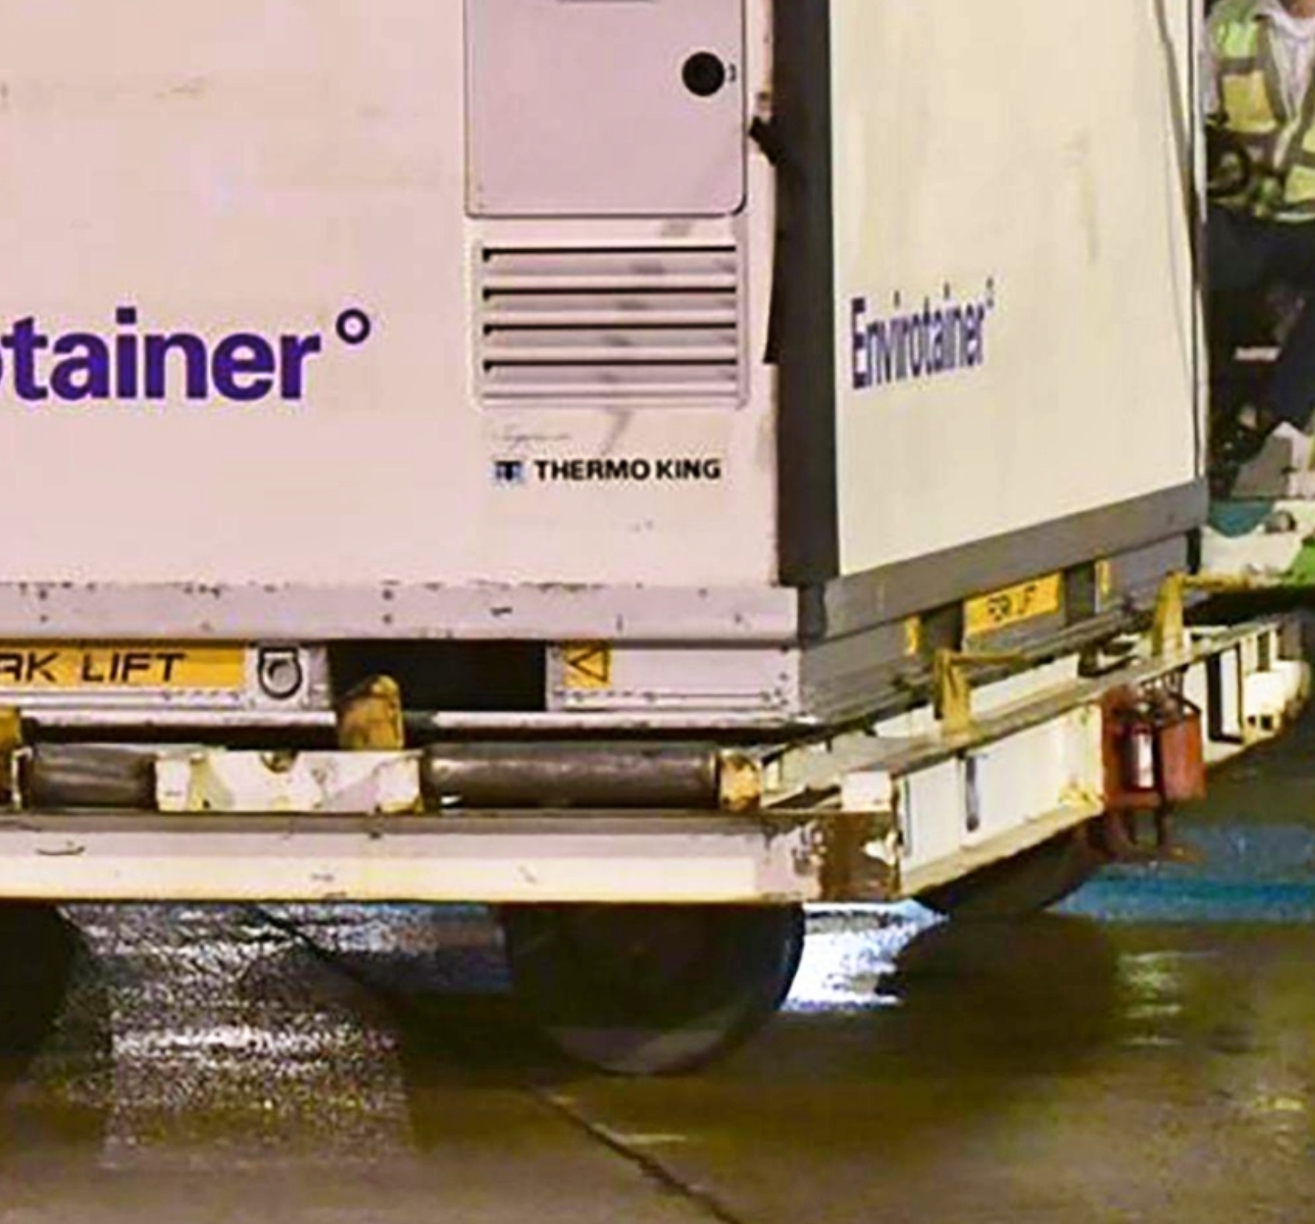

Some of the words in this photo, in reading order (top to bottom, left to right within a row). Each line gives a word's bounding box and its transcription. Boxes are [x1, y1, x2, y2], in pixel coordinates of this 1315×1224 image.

[533, 458, 651, 482] THERMO
[655, 458, 723, 481] KING
[81, 651, 187, 683] LIFT
